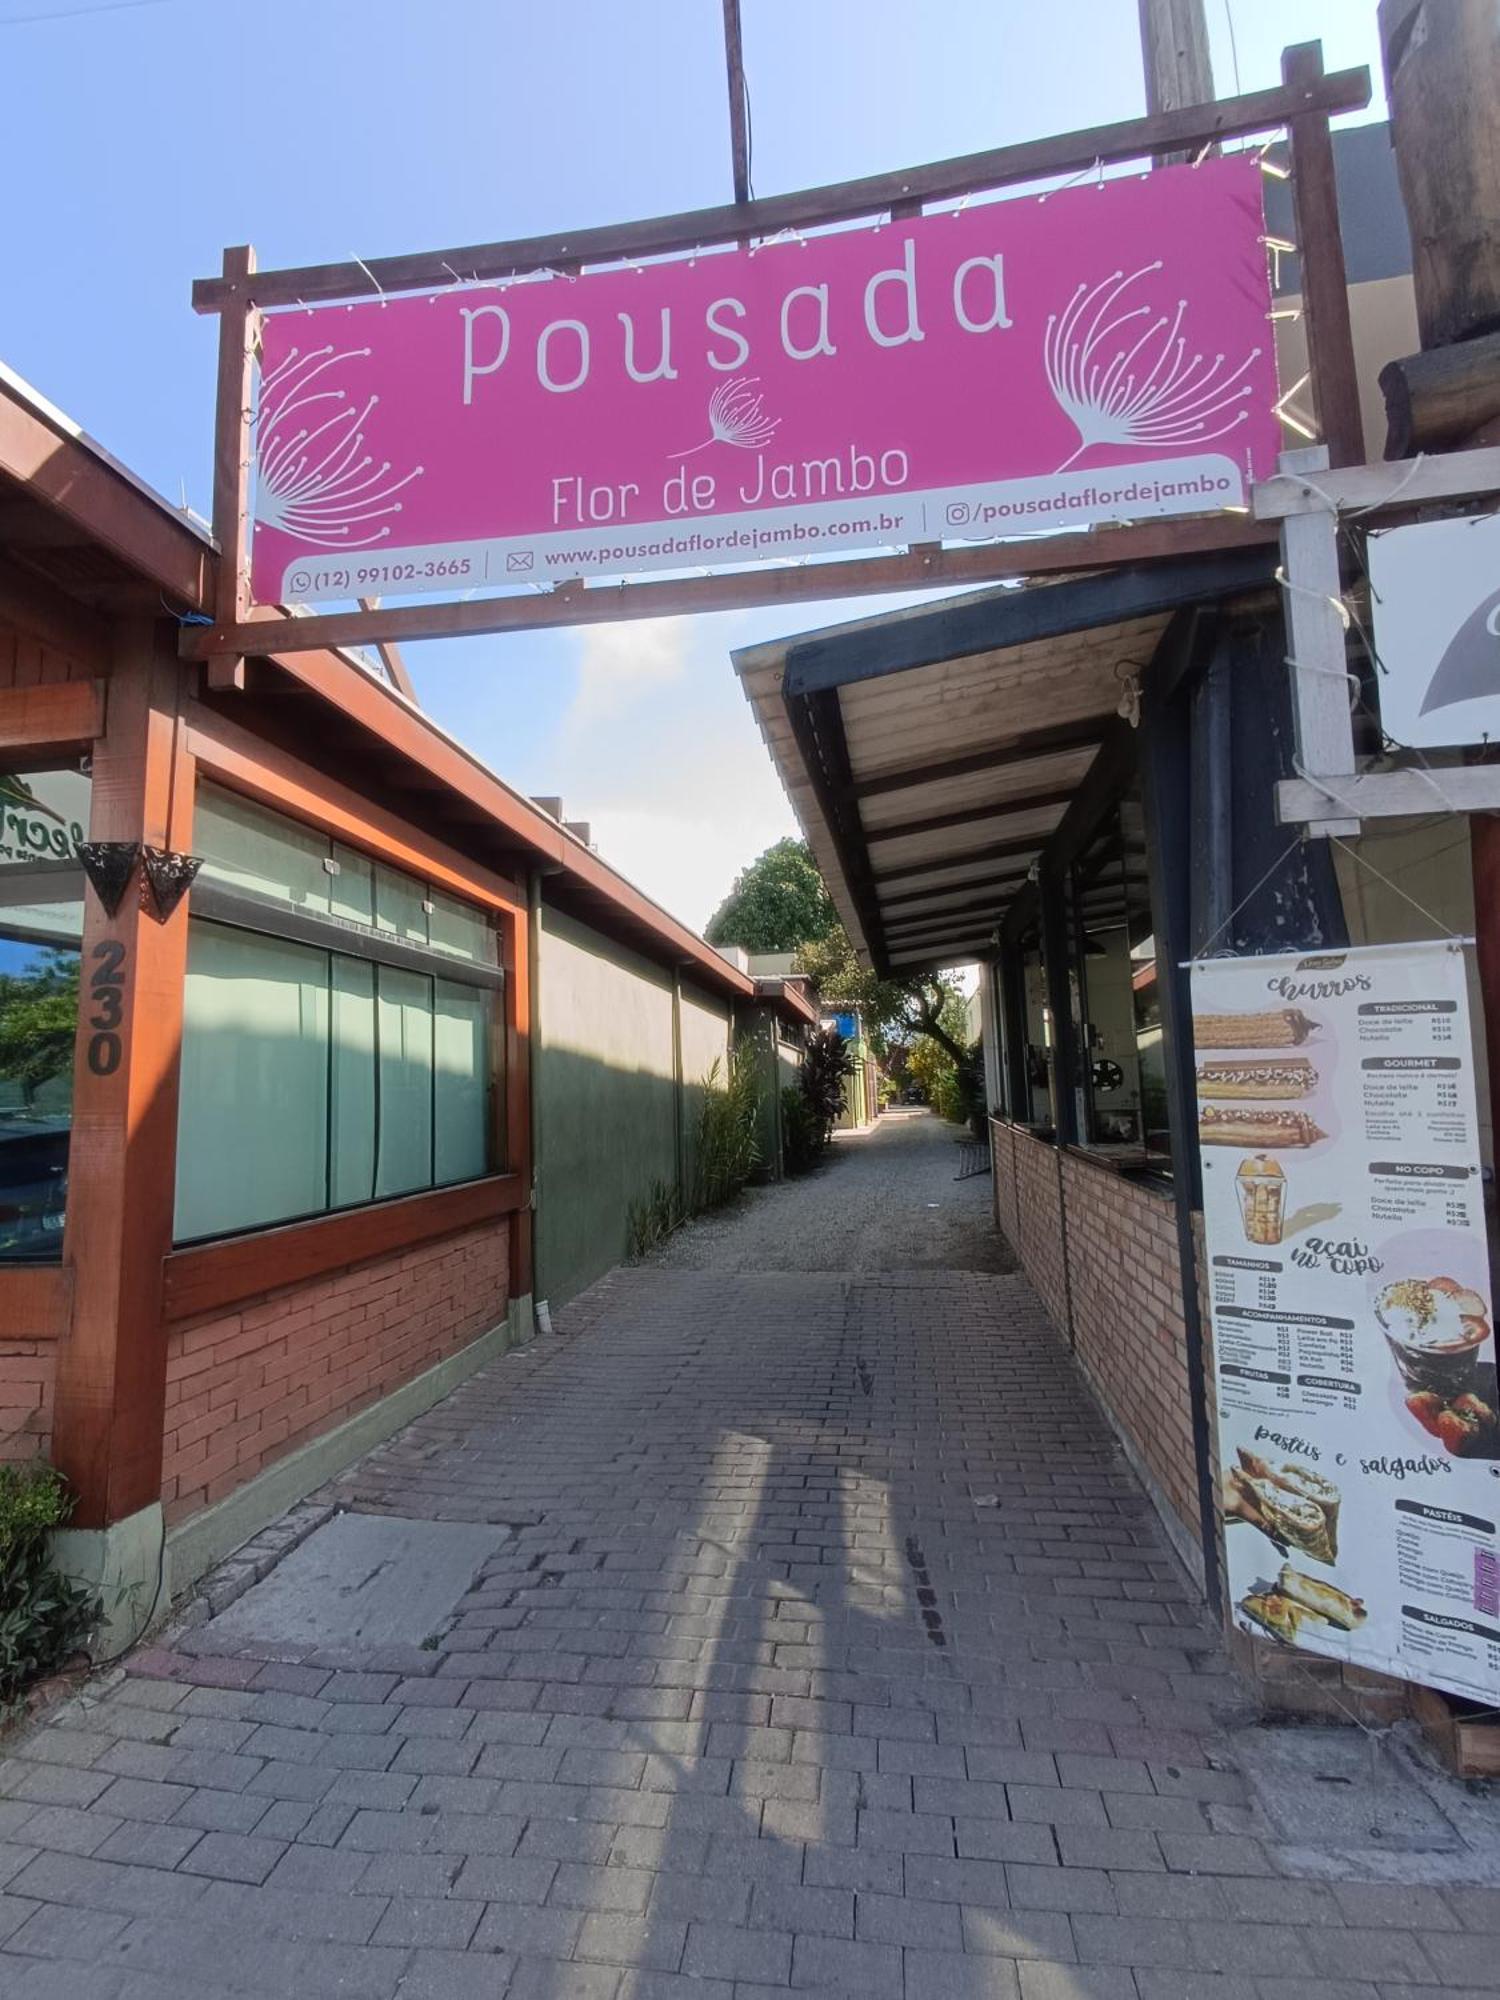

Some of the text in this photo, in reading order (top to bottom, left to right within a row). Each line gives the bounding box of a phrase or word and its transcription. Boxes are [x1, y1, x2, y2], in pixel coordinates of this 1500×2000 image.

[459, 238, 1012, 405] pousada
[552, 445, 908, 525] Flor de Jambo
[973, 475, 1230, 521] /pousadaflordejambo
[545, 512, 903, 565] www.pousadaflordejambo.com.br
[314, 559, 471, 591] (12) 99102-3665
[1267, 974, 1372, 1001] churros
[87, 939, 127, 1077] 230
[1374, 1003, 1440, 1013] TRADICIONAL
[1383, 1058, 1438, 1068] GOURMET
[1395, 1165, 1444, 1175] NO COPO
[1226, 1258, 1271, 1270] TAMANHOS
[1290, 1247, 1385, 1276] no copo
[1242, 1310, 1328, 1325] ACOMPANHAMENTOS
[1239, 1368, 1269, 1380] FRUTAS
[1304, 1377, 1356, 1391] COBERTURA
[1359, 1454, 1452, 1480] salgados
[1423, 1506, 1463, 1522] PASTÉIS
[1423, 1613, 1475, 1632] SALGADOS
